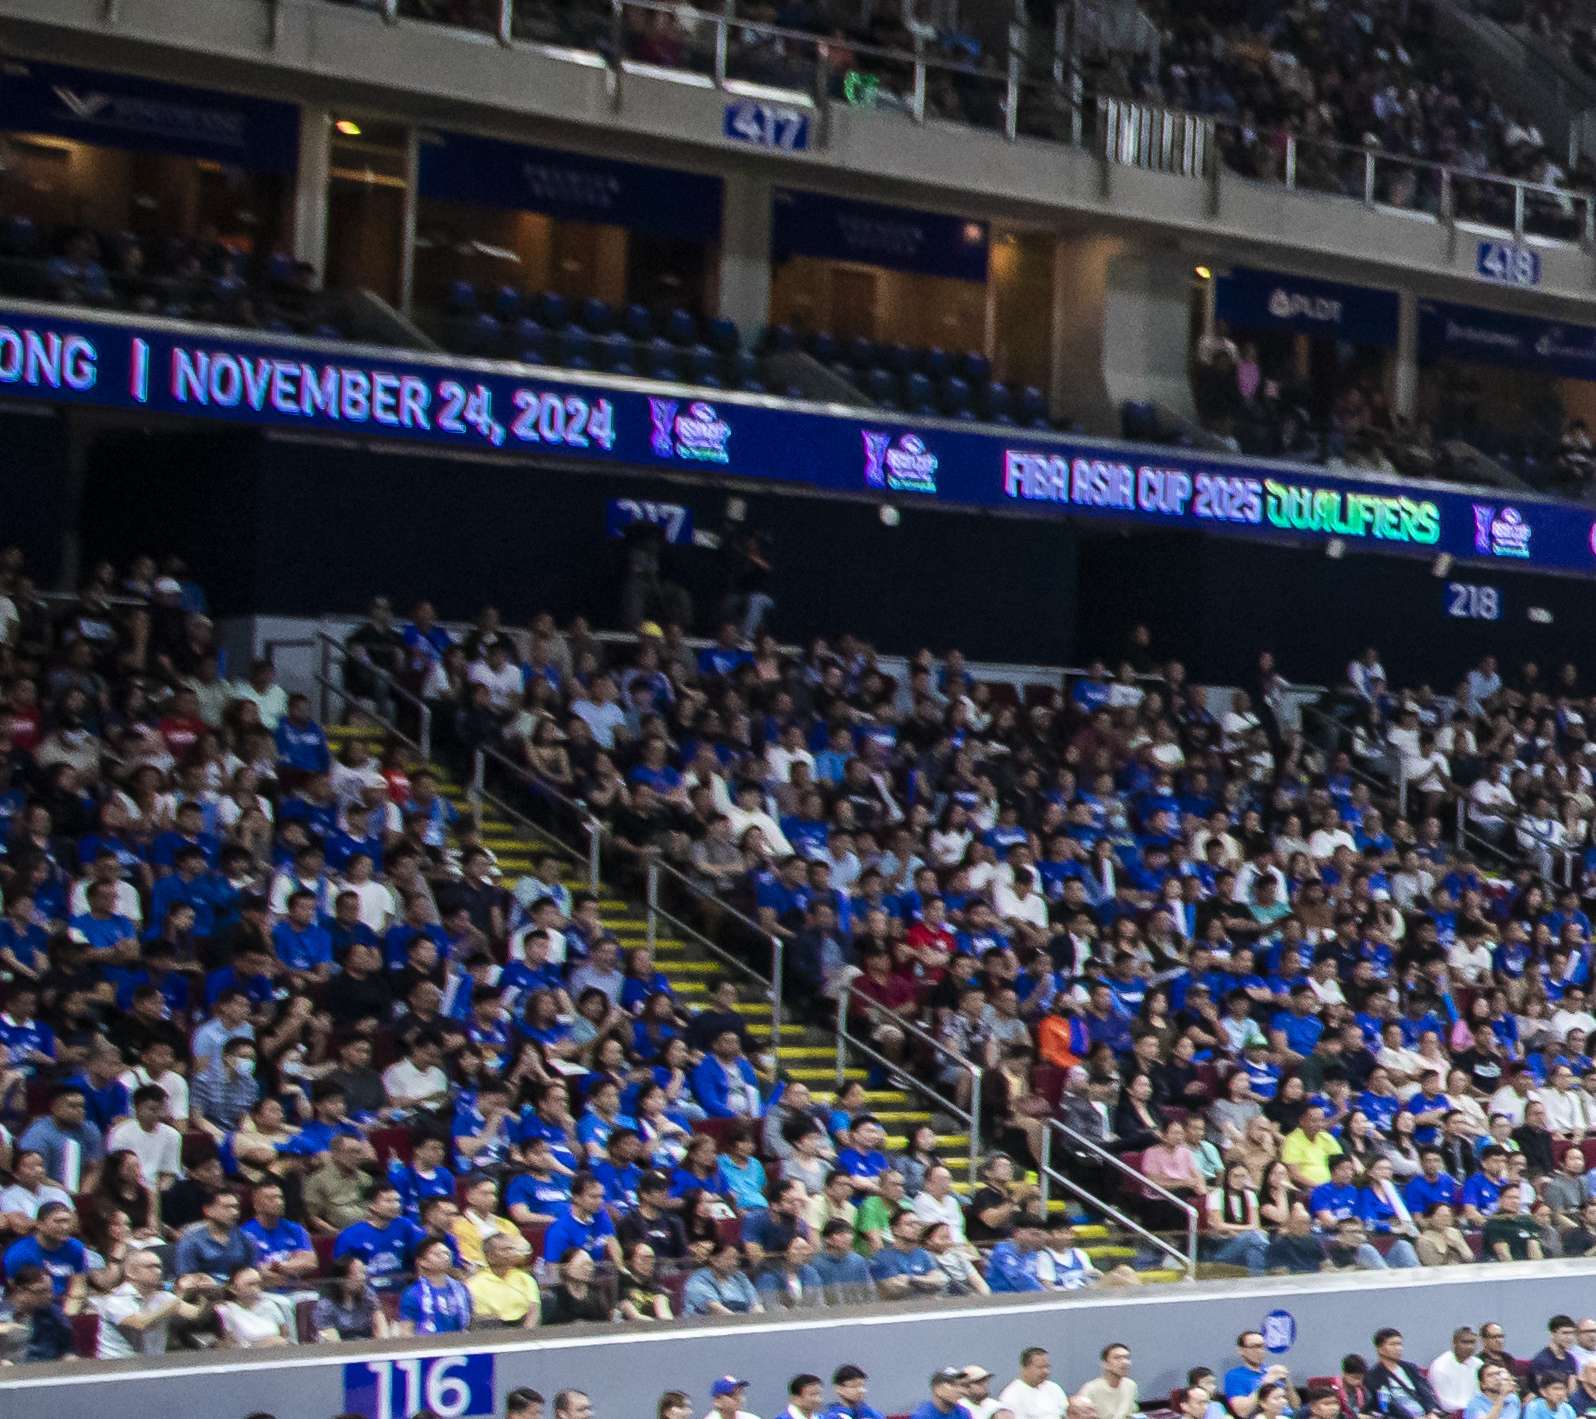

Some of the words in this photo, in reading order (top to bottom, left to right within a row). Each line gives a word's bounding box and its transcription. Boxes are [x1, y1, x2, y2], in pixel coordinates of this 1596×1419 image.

[1480, 245, 1539, 285] 418
[172, 346, 432, 431] NOVEMBER
[437, 382, 505, 446] 24,
[513, 386, 617, 452] 2024
[1003, 450, 1070, 505] FIBA
[1072, 458, 1135, 510] ASIA
[1136, 465, 1192, 517] CUP
[1193, 473, 1264, 525] 2025
[1264, 478, 1442, 548] QUALIFIERS
[1447, 583, 1500, 620] 218
[369, 1358, 472, 1419] 116
